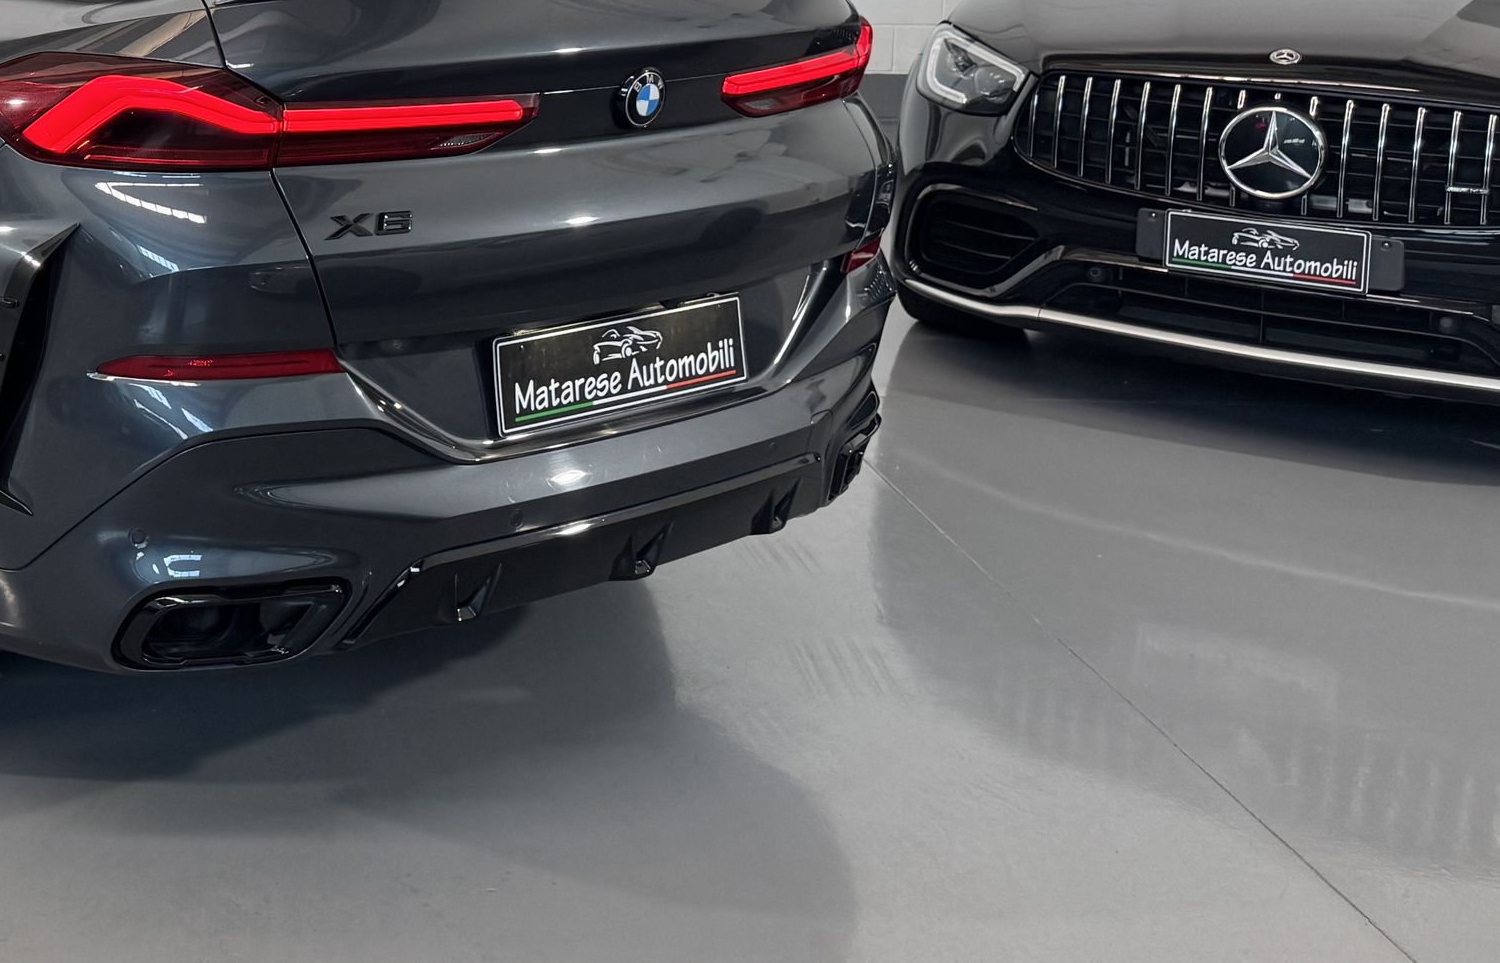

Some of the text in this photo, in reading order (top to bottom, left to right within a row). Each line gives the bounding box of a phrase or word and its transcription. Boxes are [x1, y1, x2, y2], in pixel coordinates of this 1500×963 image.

[633, 73, 665, 93] BMW
[323, 210, 413, 241] X6
[1172, 238, 1358, 281] Matarese Automobili
[514, 337, 736, 415] Matarese Automobili
